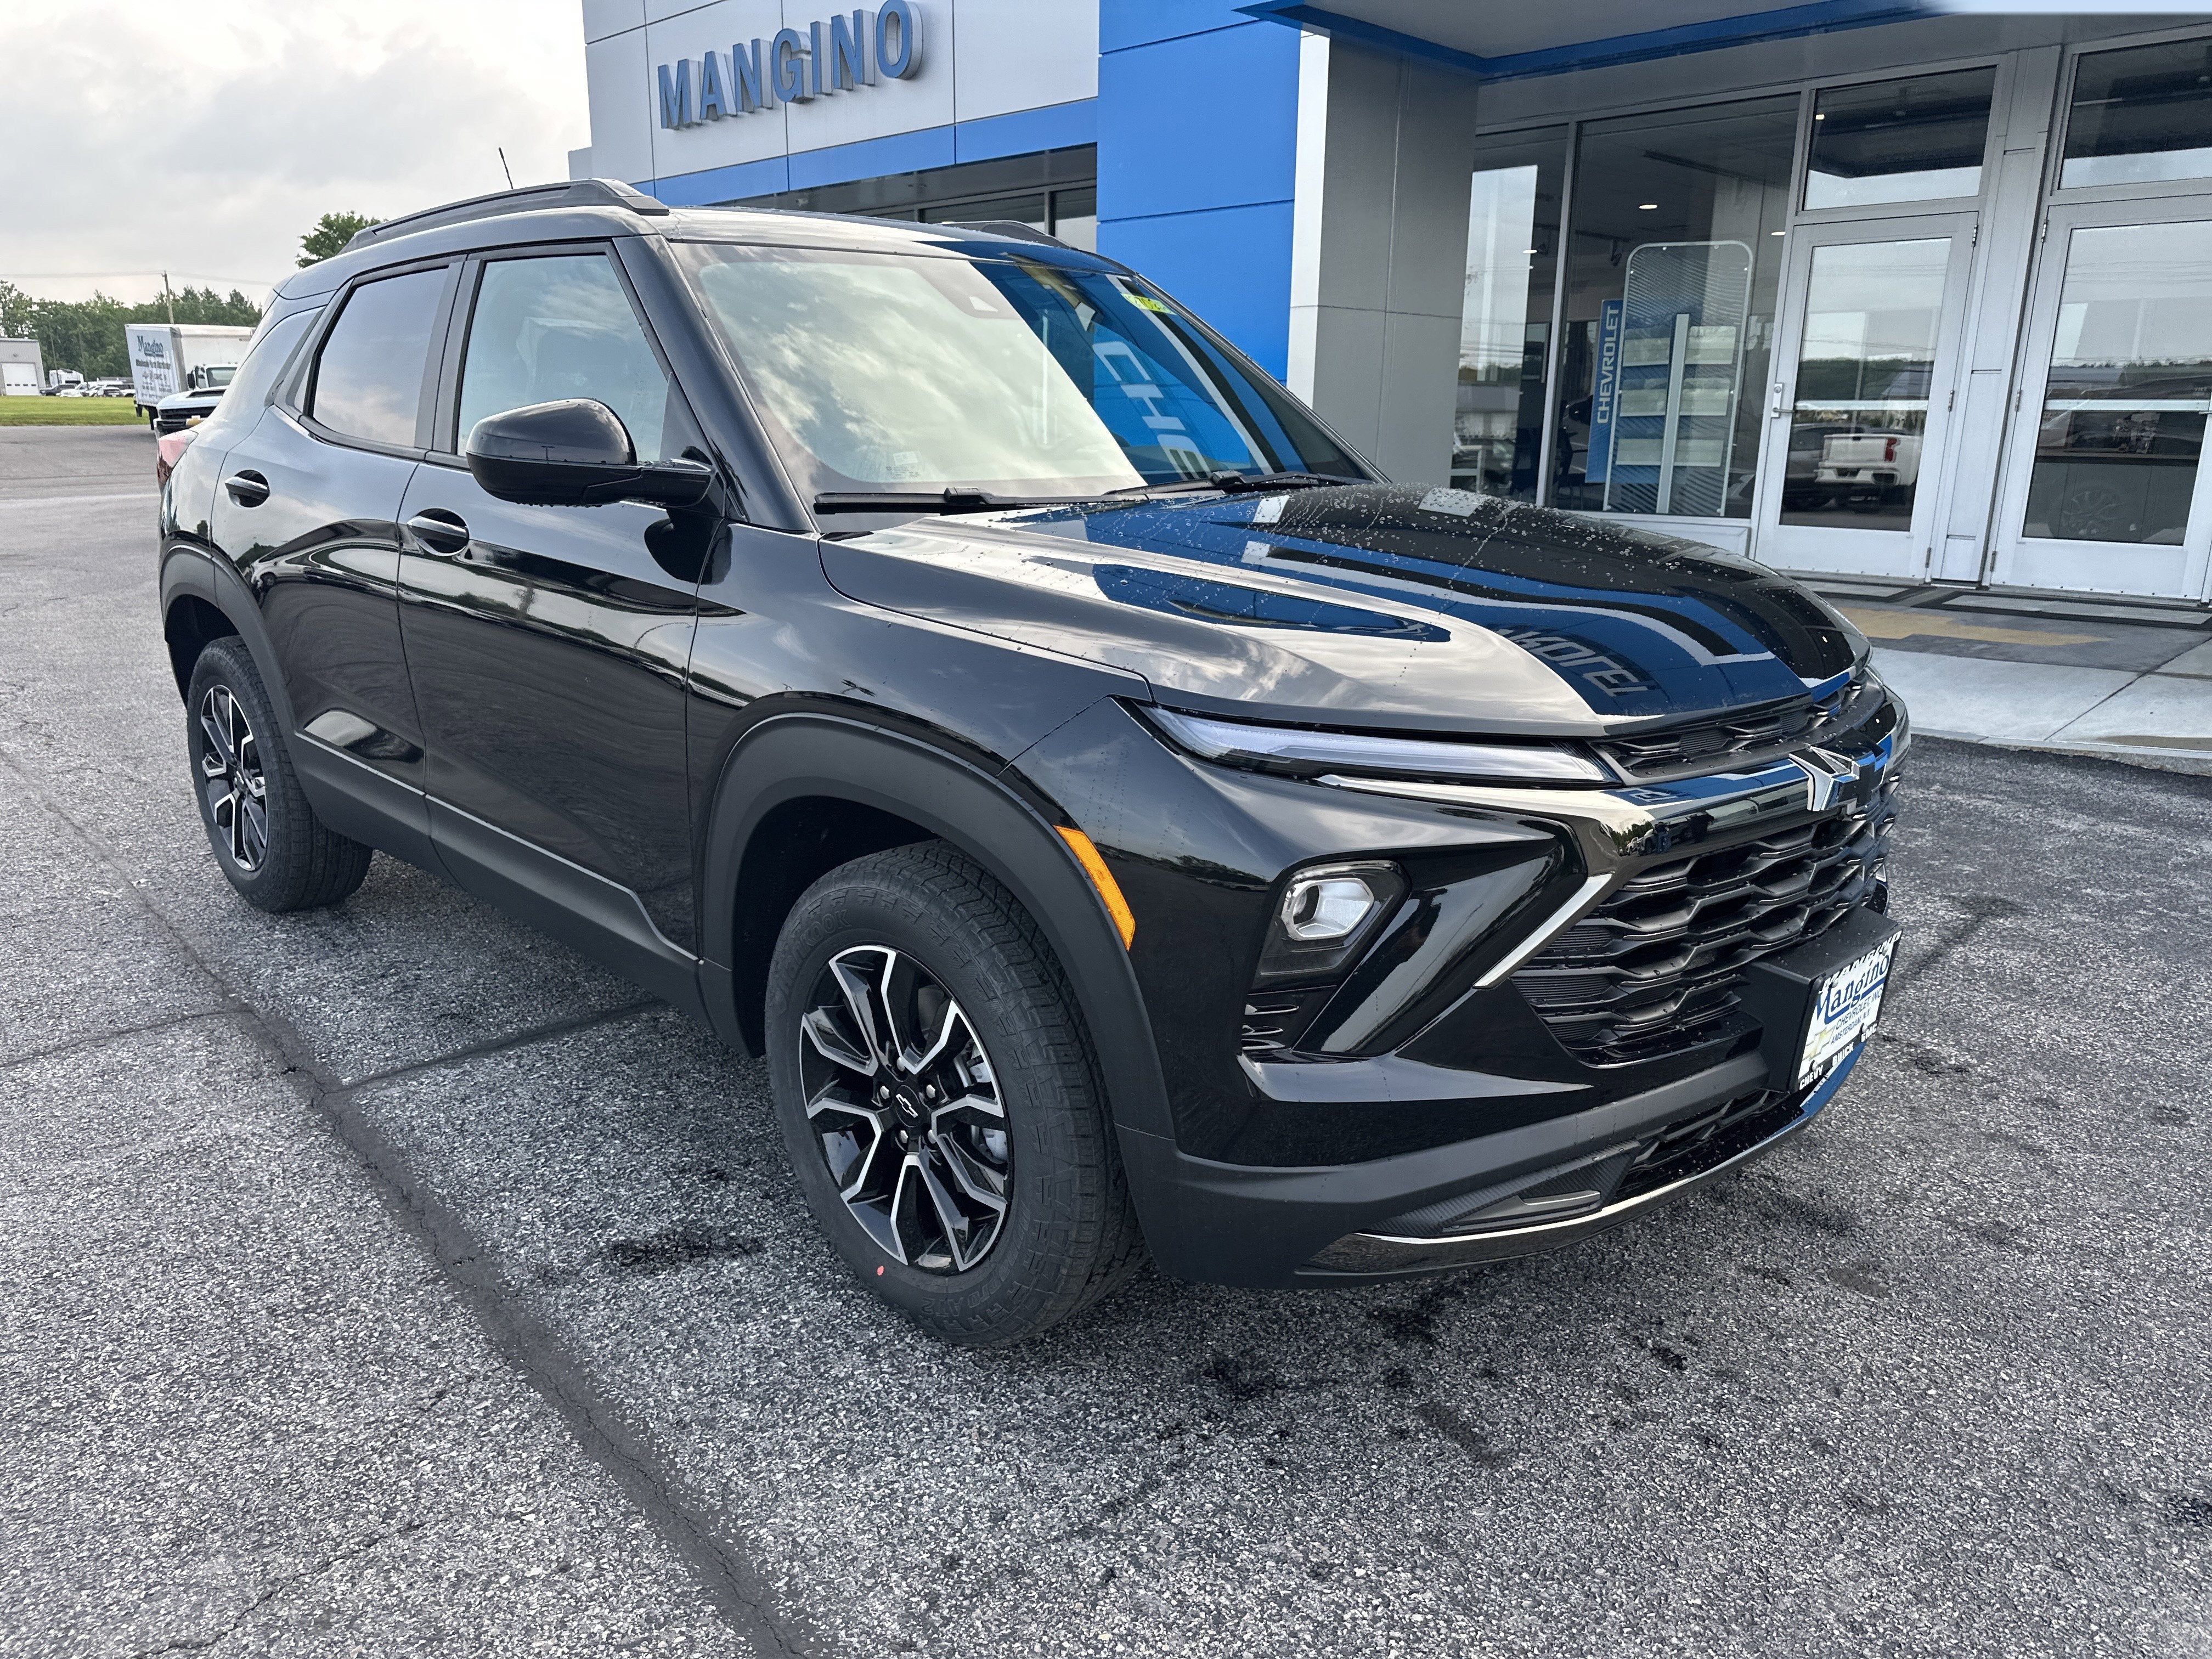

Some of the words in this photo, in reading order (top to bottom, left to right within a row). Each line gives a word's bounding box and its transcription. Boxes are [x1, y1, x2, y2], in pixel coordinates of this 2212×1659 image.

[658, 0, 923, 129] MANGINO
[137, 335, 165, 357] Mangino
[1597, 306, 1618, 424] CHEVROLET
[1816, 954, 1890, 1025] Mangino
[1799, 1064, 1824, 1091] CHEVY
[1832, 1041, 1854, 1066] BUICK
[1860, 1023, 1877, 1042] GMC
